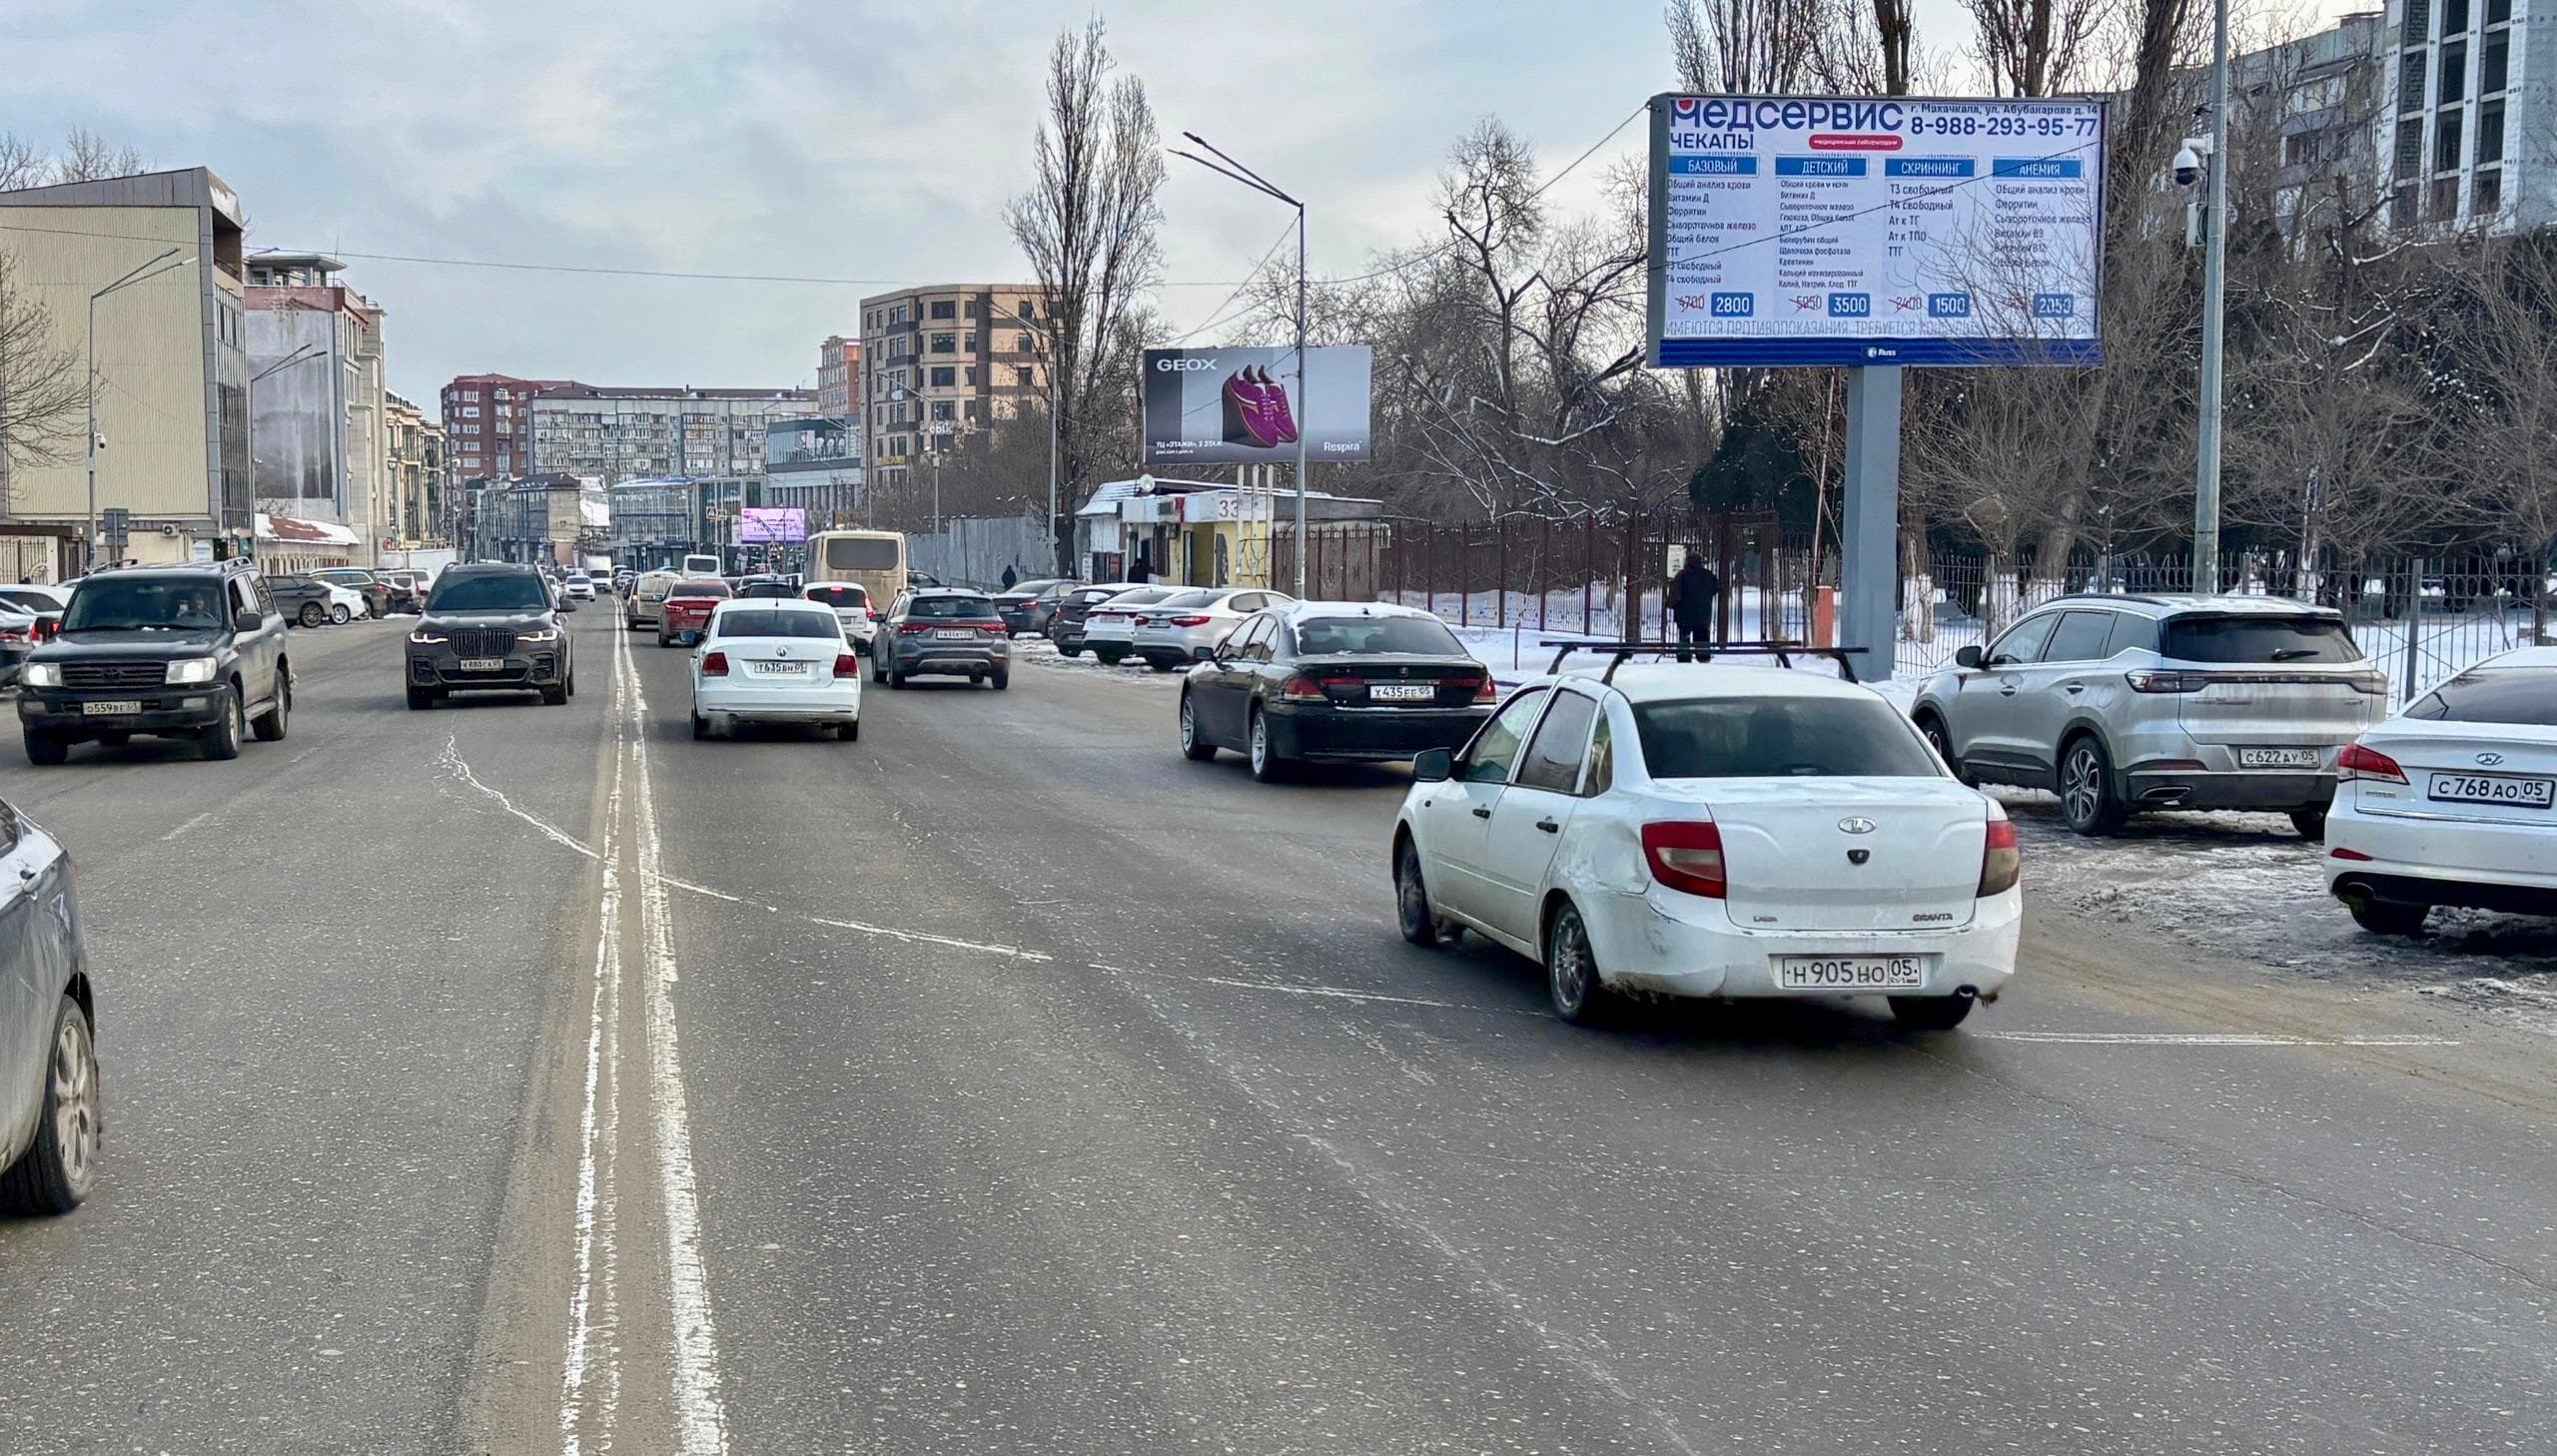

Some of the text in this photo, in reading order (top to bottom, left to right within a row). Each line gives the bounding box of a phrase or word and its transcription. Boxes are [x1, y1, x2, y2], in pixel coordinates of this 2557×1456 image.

[1921, 104, 1980, 115] Махачкала,
[1985, 106, 2000, 116] ул.
[2003, 105, 2072, 116] Абубакарова
[2075, 106, 2084, 116] д.
[2088, 105, 2098, 115] 14
[1911, 116, 2098, 137] 8-988-293-95-77
[1670, 133, 1754, 150] ЧЕКАПЫ
[1687, 158, 1737, 173] БАЗОВЫЙ
[1801, 159, 1848, 175] ДЕТСКИЙ
[1901, 161, 1961, 175] СКРИННИНГ
[2019, 162, 2061, 177] АНЕМИЯ
[1727, 182, 1751, 191] крови
[1890, 184, 1954, 196] Т3 свободный
[1996, 184, 2026, 195] Общий
[1902, 200, 1954, 211] свободный
[1995, 200, 2038, 211] Ферритин
[1908, 231, 1927, 242] ТПО
[1889, 246, 1903, 257] ТТГ
[1677, 261, 1722, 271] свободный
[1676, 275, 1722, 285] свободный
[1716, 297, 1750, 313] 2800
[1834, 297, 1867, 313] 3500
[1936, 298, 1966, 314] 1500
[2039, 298, 2072, 314] 2050
[1666, 320, 1723, 336] ИМЕЮТСЯ
[1855, 321, 1916, 336] ТРЕБУЕТСЯ
[1157, 359, 1218, 371] GEOX
